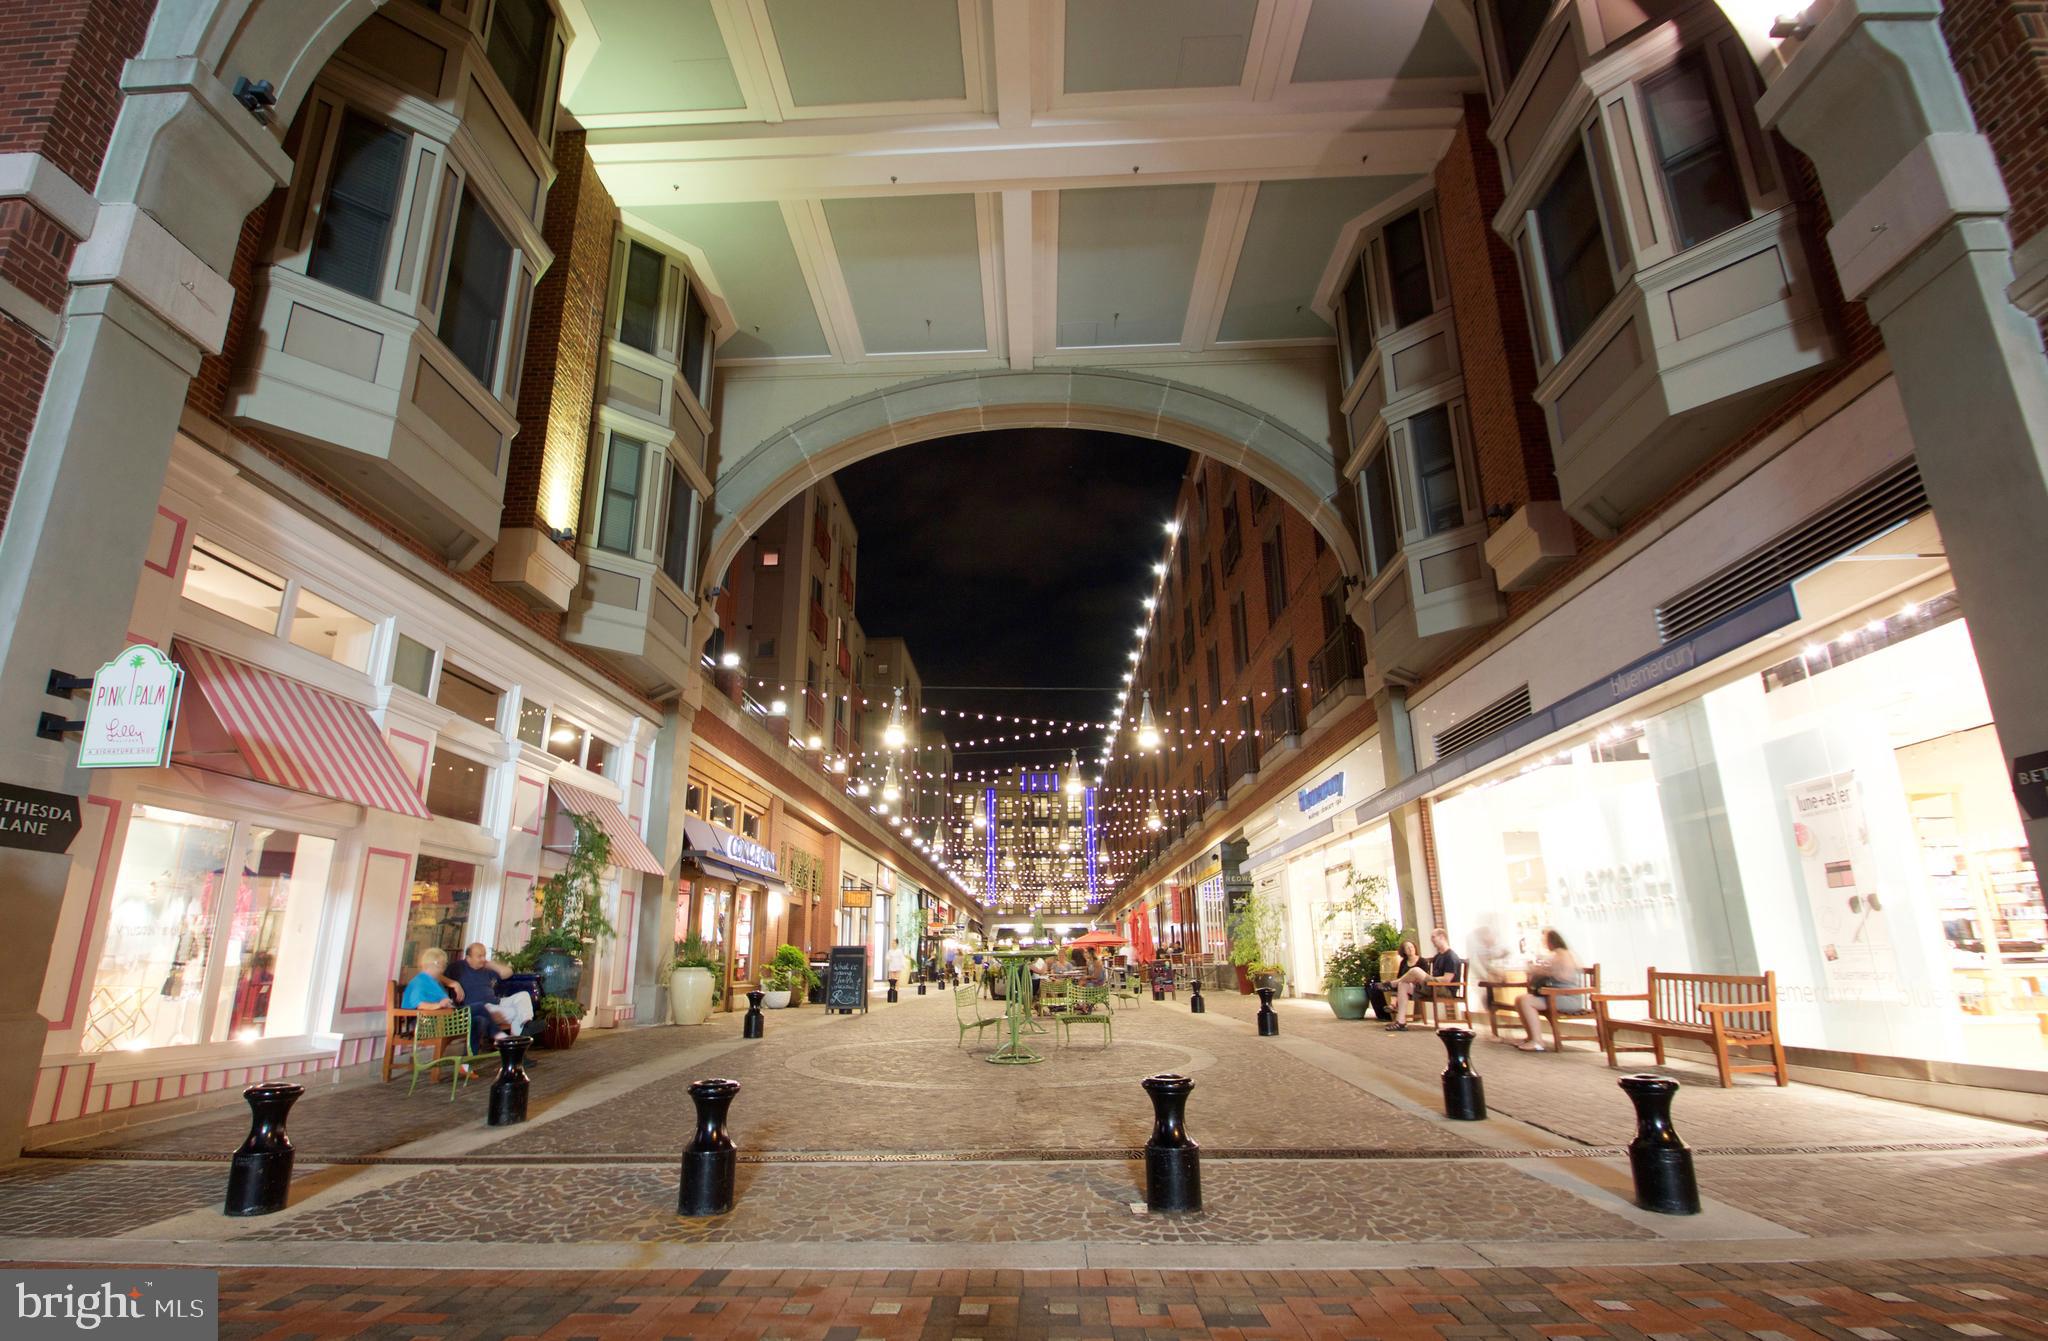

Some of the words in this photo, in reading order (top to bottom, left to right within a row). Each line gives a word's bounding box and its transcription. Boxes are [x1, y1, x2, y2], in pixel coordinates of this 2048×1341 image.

[1609, 641, 1696, 697] bluemercury
[97, 686, 127, 706] PINK
[134, 684, 165, 706] PALM
[106, 718, 145, 744] Lilly
[0, 817, 49, 836] LANE
